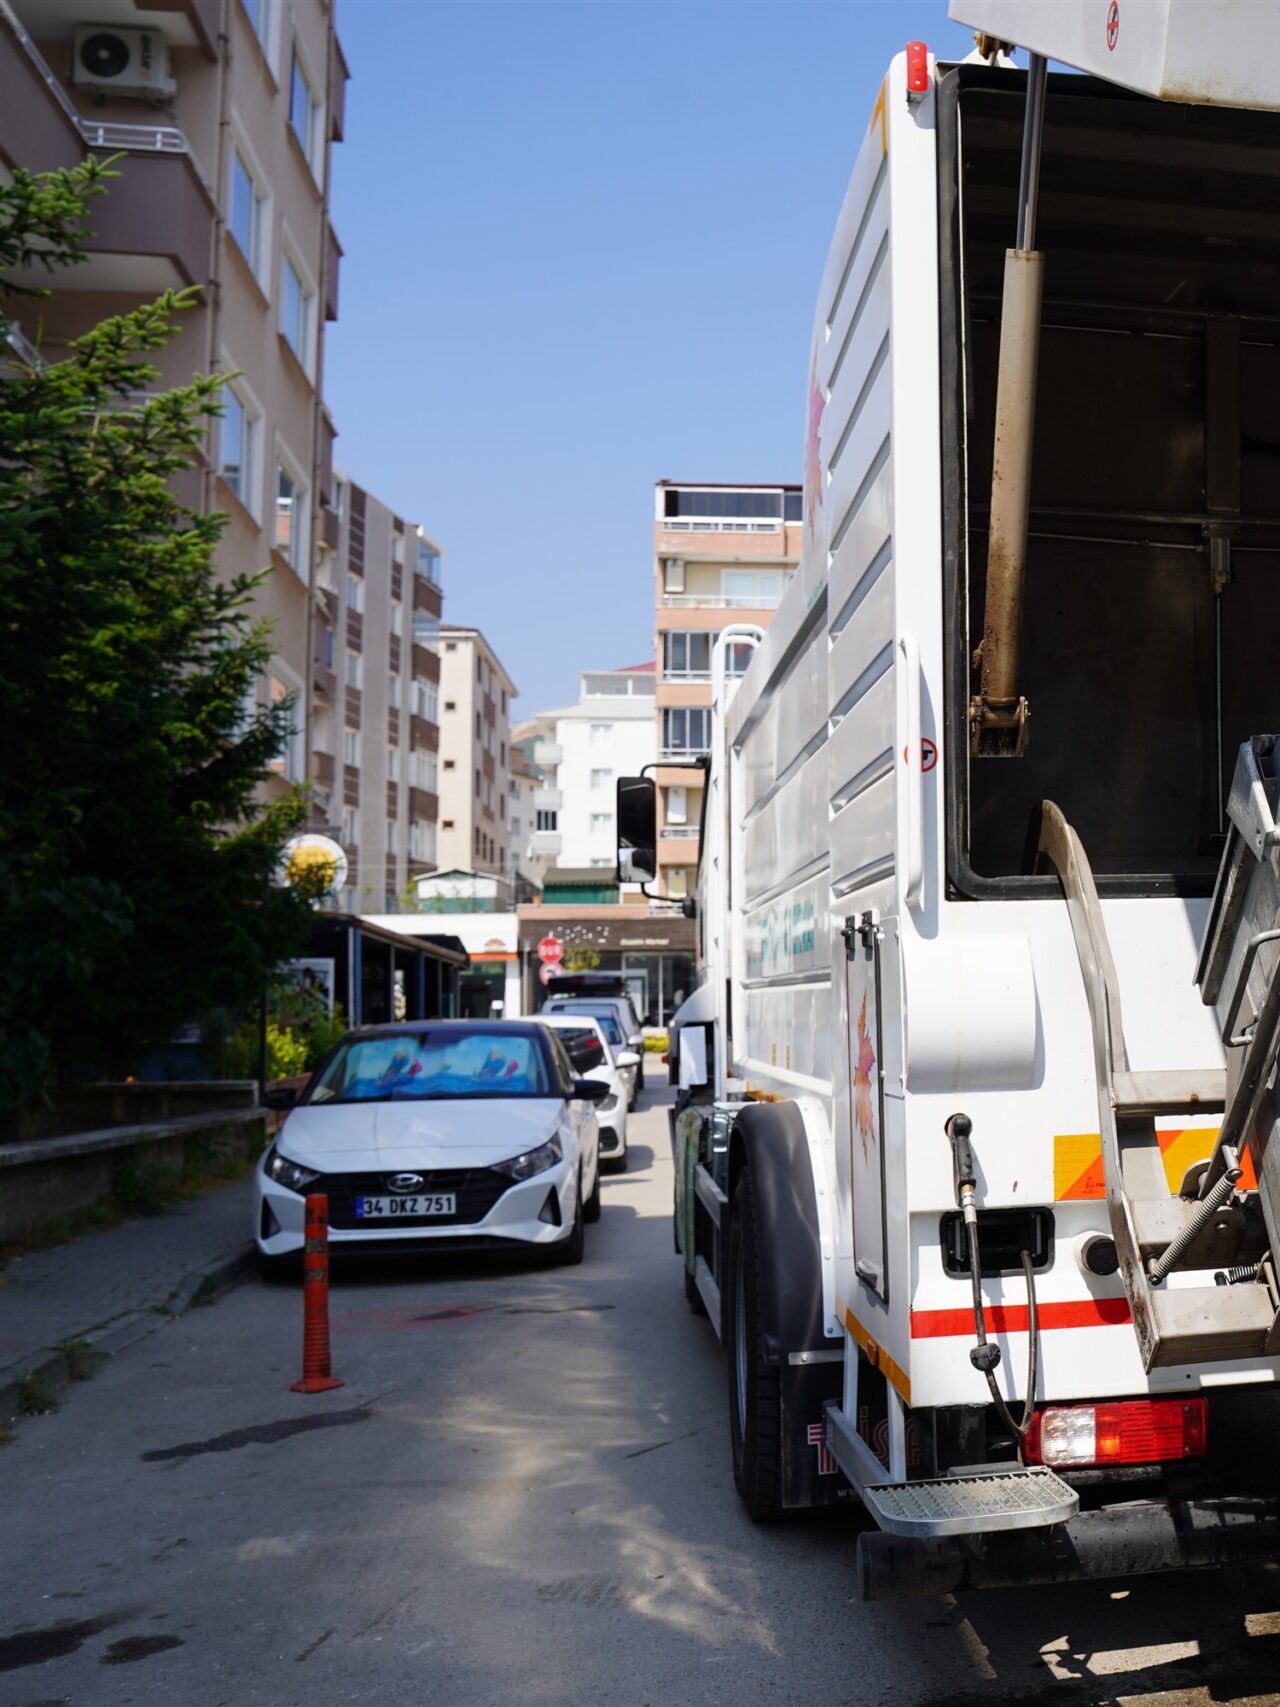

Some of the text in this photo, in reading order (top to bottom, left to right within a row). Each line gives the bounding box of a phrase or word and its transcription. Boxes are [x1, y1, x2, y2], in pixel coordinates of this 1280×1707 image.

[364, 1197, 452, 1214] 34 DKZ 751
